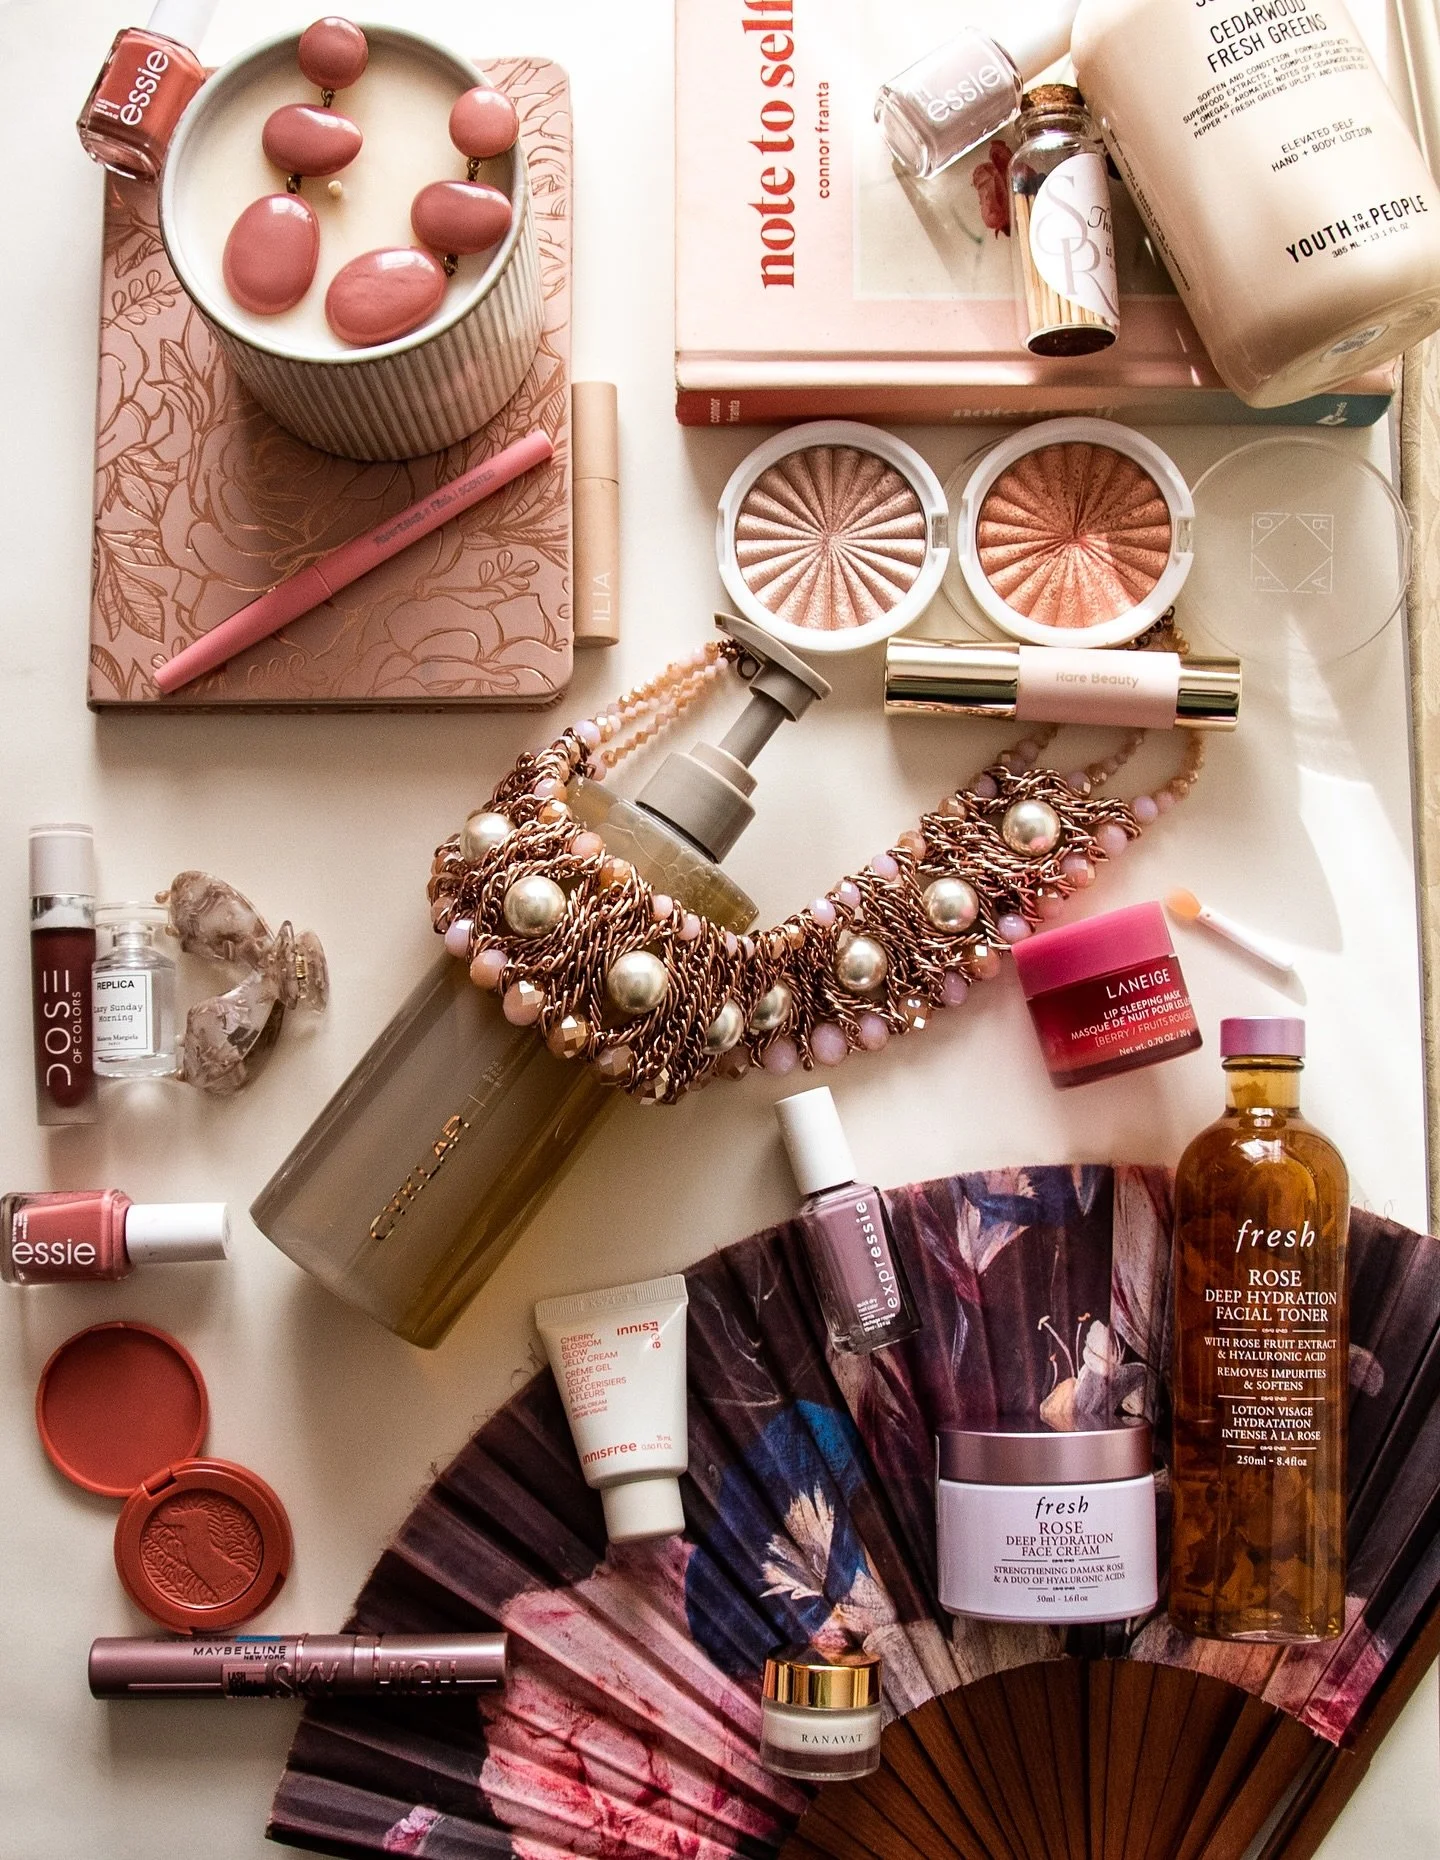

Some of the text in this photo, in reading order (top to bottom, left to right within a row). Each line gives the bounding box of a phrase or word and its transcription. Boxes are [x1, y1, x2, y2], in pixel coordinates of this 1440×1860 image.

[1208, 14, 1326, 73] FRESH GREENS
[120, 50, 168, 125] essie
[1183, 94, 1224, 124] SUPERFOOD
[1280, 54, 1312, 70] COMPLEX
[1197, 82, 1226, 103] SOFTEN
[1229, 73, 1244, 84] AND
[1234, 80, 1274, 102] AROMATIC
[1276, 69, 1299, 82] NOTES
[1301, 64, 1309, 72] OF
[927, 65, 1001, 122] essie
[1194, 118, 1221, 139] PEPPER
[1230, 99, 1256, 116] FRESH
[1257, 84, 1287, 102] GREENS
[1289, 73, 1316, 87] UPLIFT
[748, 100, 795, 155] to
[1281, 118, 1354, 153] ELEVATED SELF
[815, 82, 830, 199] connor franta
[1272, 153, 1299, 172] HAND
[1312, 137, 1337, 153] BODY
[1340, 127, 1372, 142] LOTION
[748, 166, 795, 288] note
[1286, 195, 1428, 263] YOUTH TO PEOPLE
[1354, 221, 1371, 232] THE
[1332, 247, 1348, 258] 385
[1390, 227, 1398, 235] FL
[592, 572, 610, 620] ILIA
[1056, 672, 1140, 688] Rare Beauty
[96, 980, 135, 990] REPLICA
[1106, 968, 1171, 999] LANEIGE
[110, 1004, 143, 1012] Sunday
[1104, 990, 1181, 1020] LIP SLEEPING MASK
[98, 1014, 133, 1023] Morning
[1072, 1022, 1110, 1040] MASQUE
[1112, 1018, 1126, 1028] DE
[1127, 1010, 1150, 1023] NUIT
[1152, 1002, 1174, 1016] POUR
[1175, 999, 1184, 1009] LES
[1138, 1017, 1168, 1034] FRUITS
[43, 969, 72, 1086] DOSE
[72, 992, 82, 1064] OF COLORS
[1119, 1046, 1134, 1056] Net
[1135, 1043, 1147, 1052] wt.
[1148, 1036, 1163, 1047] 0.70
[1235, 1219, 1316, 1253] fresh
[12, 1239, 96, 1265] essie
[856, 1201, 898, 1308] expressie
[1249, 1269, 1302, 1286] ROSE
[1205, 1290, 1337, 1305] DEEP HYDRATION
[1216, 1306, 1329, 1322] FACIAL TONER
[561, 1333, 594, 1344] CHERRY
[562, 1339, 602, 1352] BLOSSOM
[1204, 1337, 1337, 1349] WITH ROSE FRUIT EXTRACT
[562, 1348, 587, 1360] GLOW
[564, 1351, 618, 1368] JELLY CREAM
[1218, 1350, 1326, 1361] & HYALURONIC ACID
[596, 1364, 612, 1372] GEL
[1217, 1367, 1326, 1379] REMOVES IMPURITIES
[569, 1376, 626, 1396] AUX CERISIERS
[576, 1388, 605, 1401] FLEURS
[1244, 1381, 1304, 1391] & SOFTENS
[1232, 1405, 1313, 1416] LOTION VISAGE
[1233, 1418, 1311, 1428] HYDRATATION
[1222, 1429, 1321, 1440] INTENSE À LA ROSE
[1236, 1455, 1266, 1466] 250ml
[1035, 1496, 1089, 1519] fresh
[1039, 1521, 1083, 1534] ROSE
[1006, 1533, 1113, 1545] DEEP HYDRATION
[1022, 1545, 1100, 1556] FACE CREAM
[994, 1562, 1124, 1575] STRENGTHENING DAMASK ROSE
[1003, 1576, 1009, 1584] A
[1011, 1576, 1030, 1584] DUO
[1046, 1575, 1103, 1584] HYALURONIC
[1105, 1572, 1125, 1581] ACIDS
[1036, 1595, 1056, 1603] 50ml
[193, 1646, 286, 1656] MAYBELLINE
[801, 1734, 863, 1744] RANAVAT
